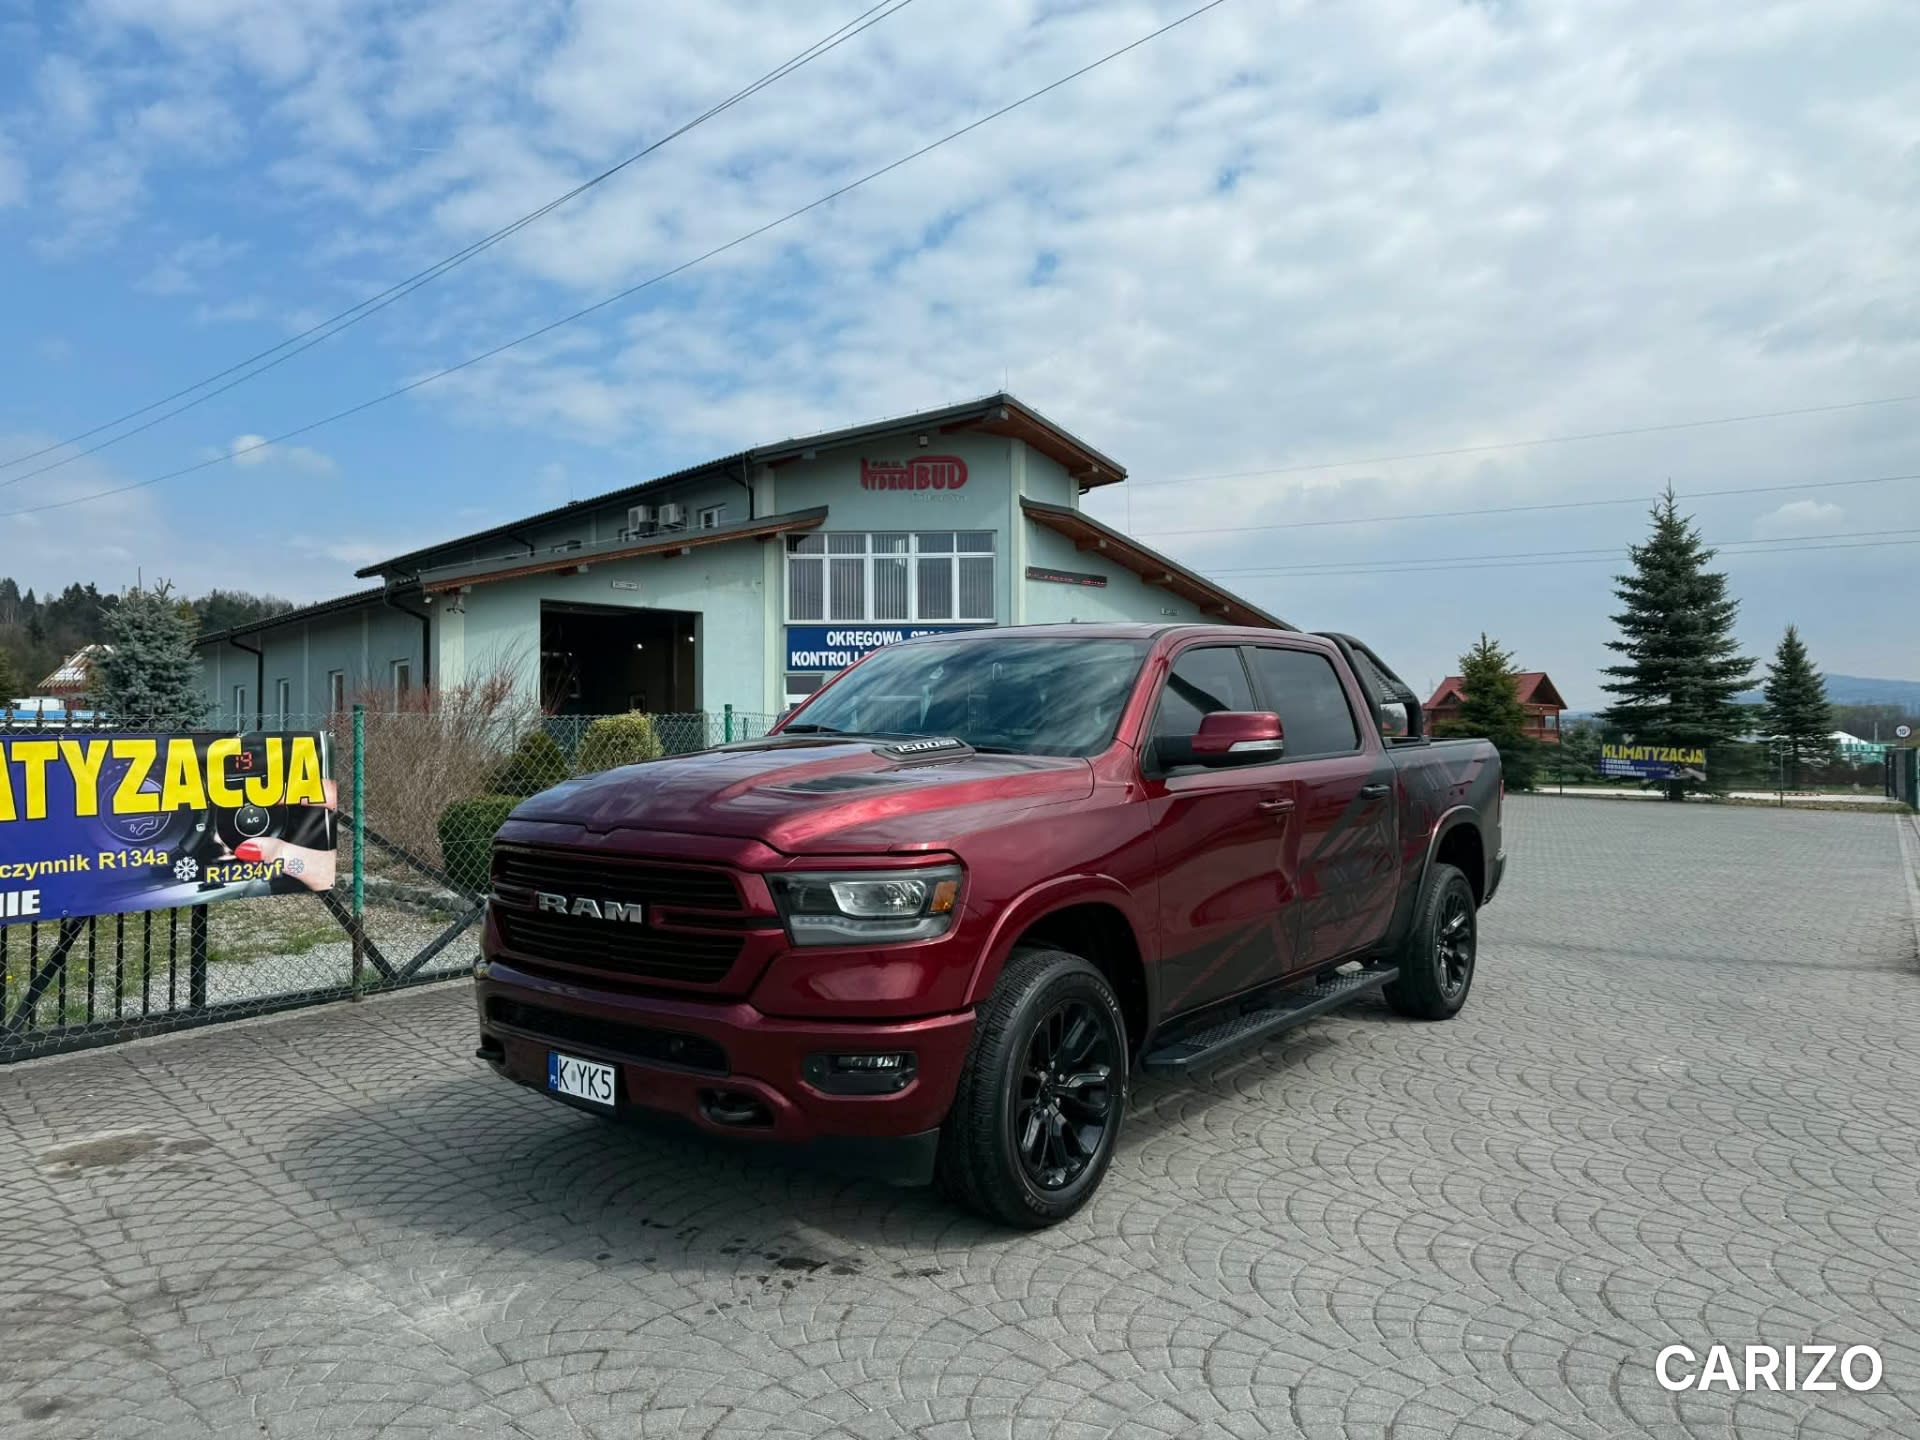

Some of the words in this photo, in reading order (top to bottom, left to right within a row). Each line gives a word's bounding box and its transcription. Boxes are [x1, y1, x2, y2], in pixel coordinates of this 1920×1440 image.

[827, 631, 903, 649] OKRĘGOWA
[896, 740, 938, 753] 1500
[1602, 744, 1704, 763] KLIMATYZACJA
[98, 849, 169, 870] R134a
[206, 859, 283, 883] R1234yf
[0, 889, 40, 918] IE
[535, 891, 642, 923] RAM
